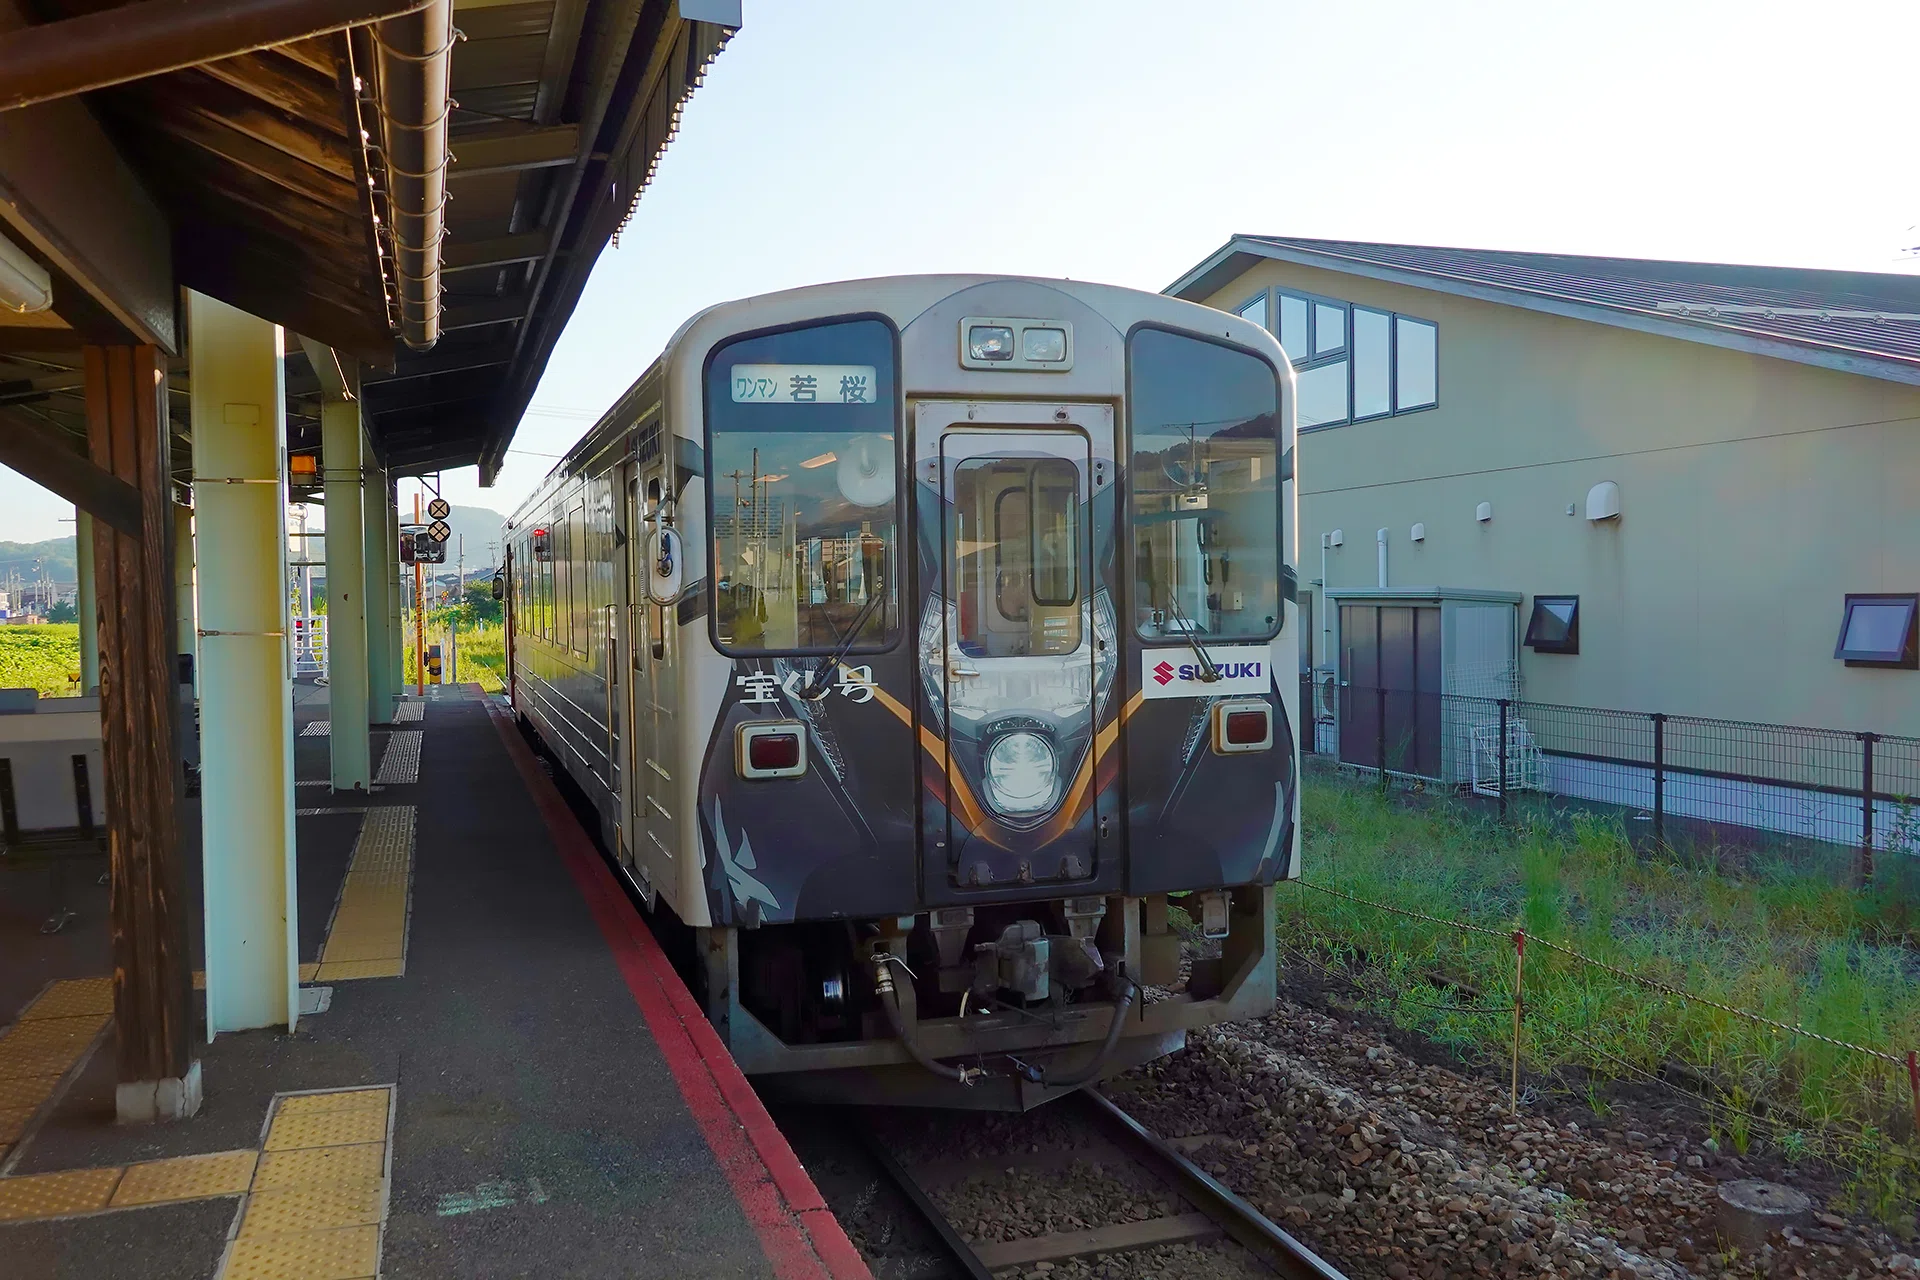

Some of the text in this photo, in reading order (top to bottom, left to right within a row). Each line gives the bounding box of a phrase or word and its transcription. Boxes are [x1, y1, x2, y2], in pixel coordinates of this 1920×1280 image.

[737, 374, 867, 403] ワンマン 若桜
